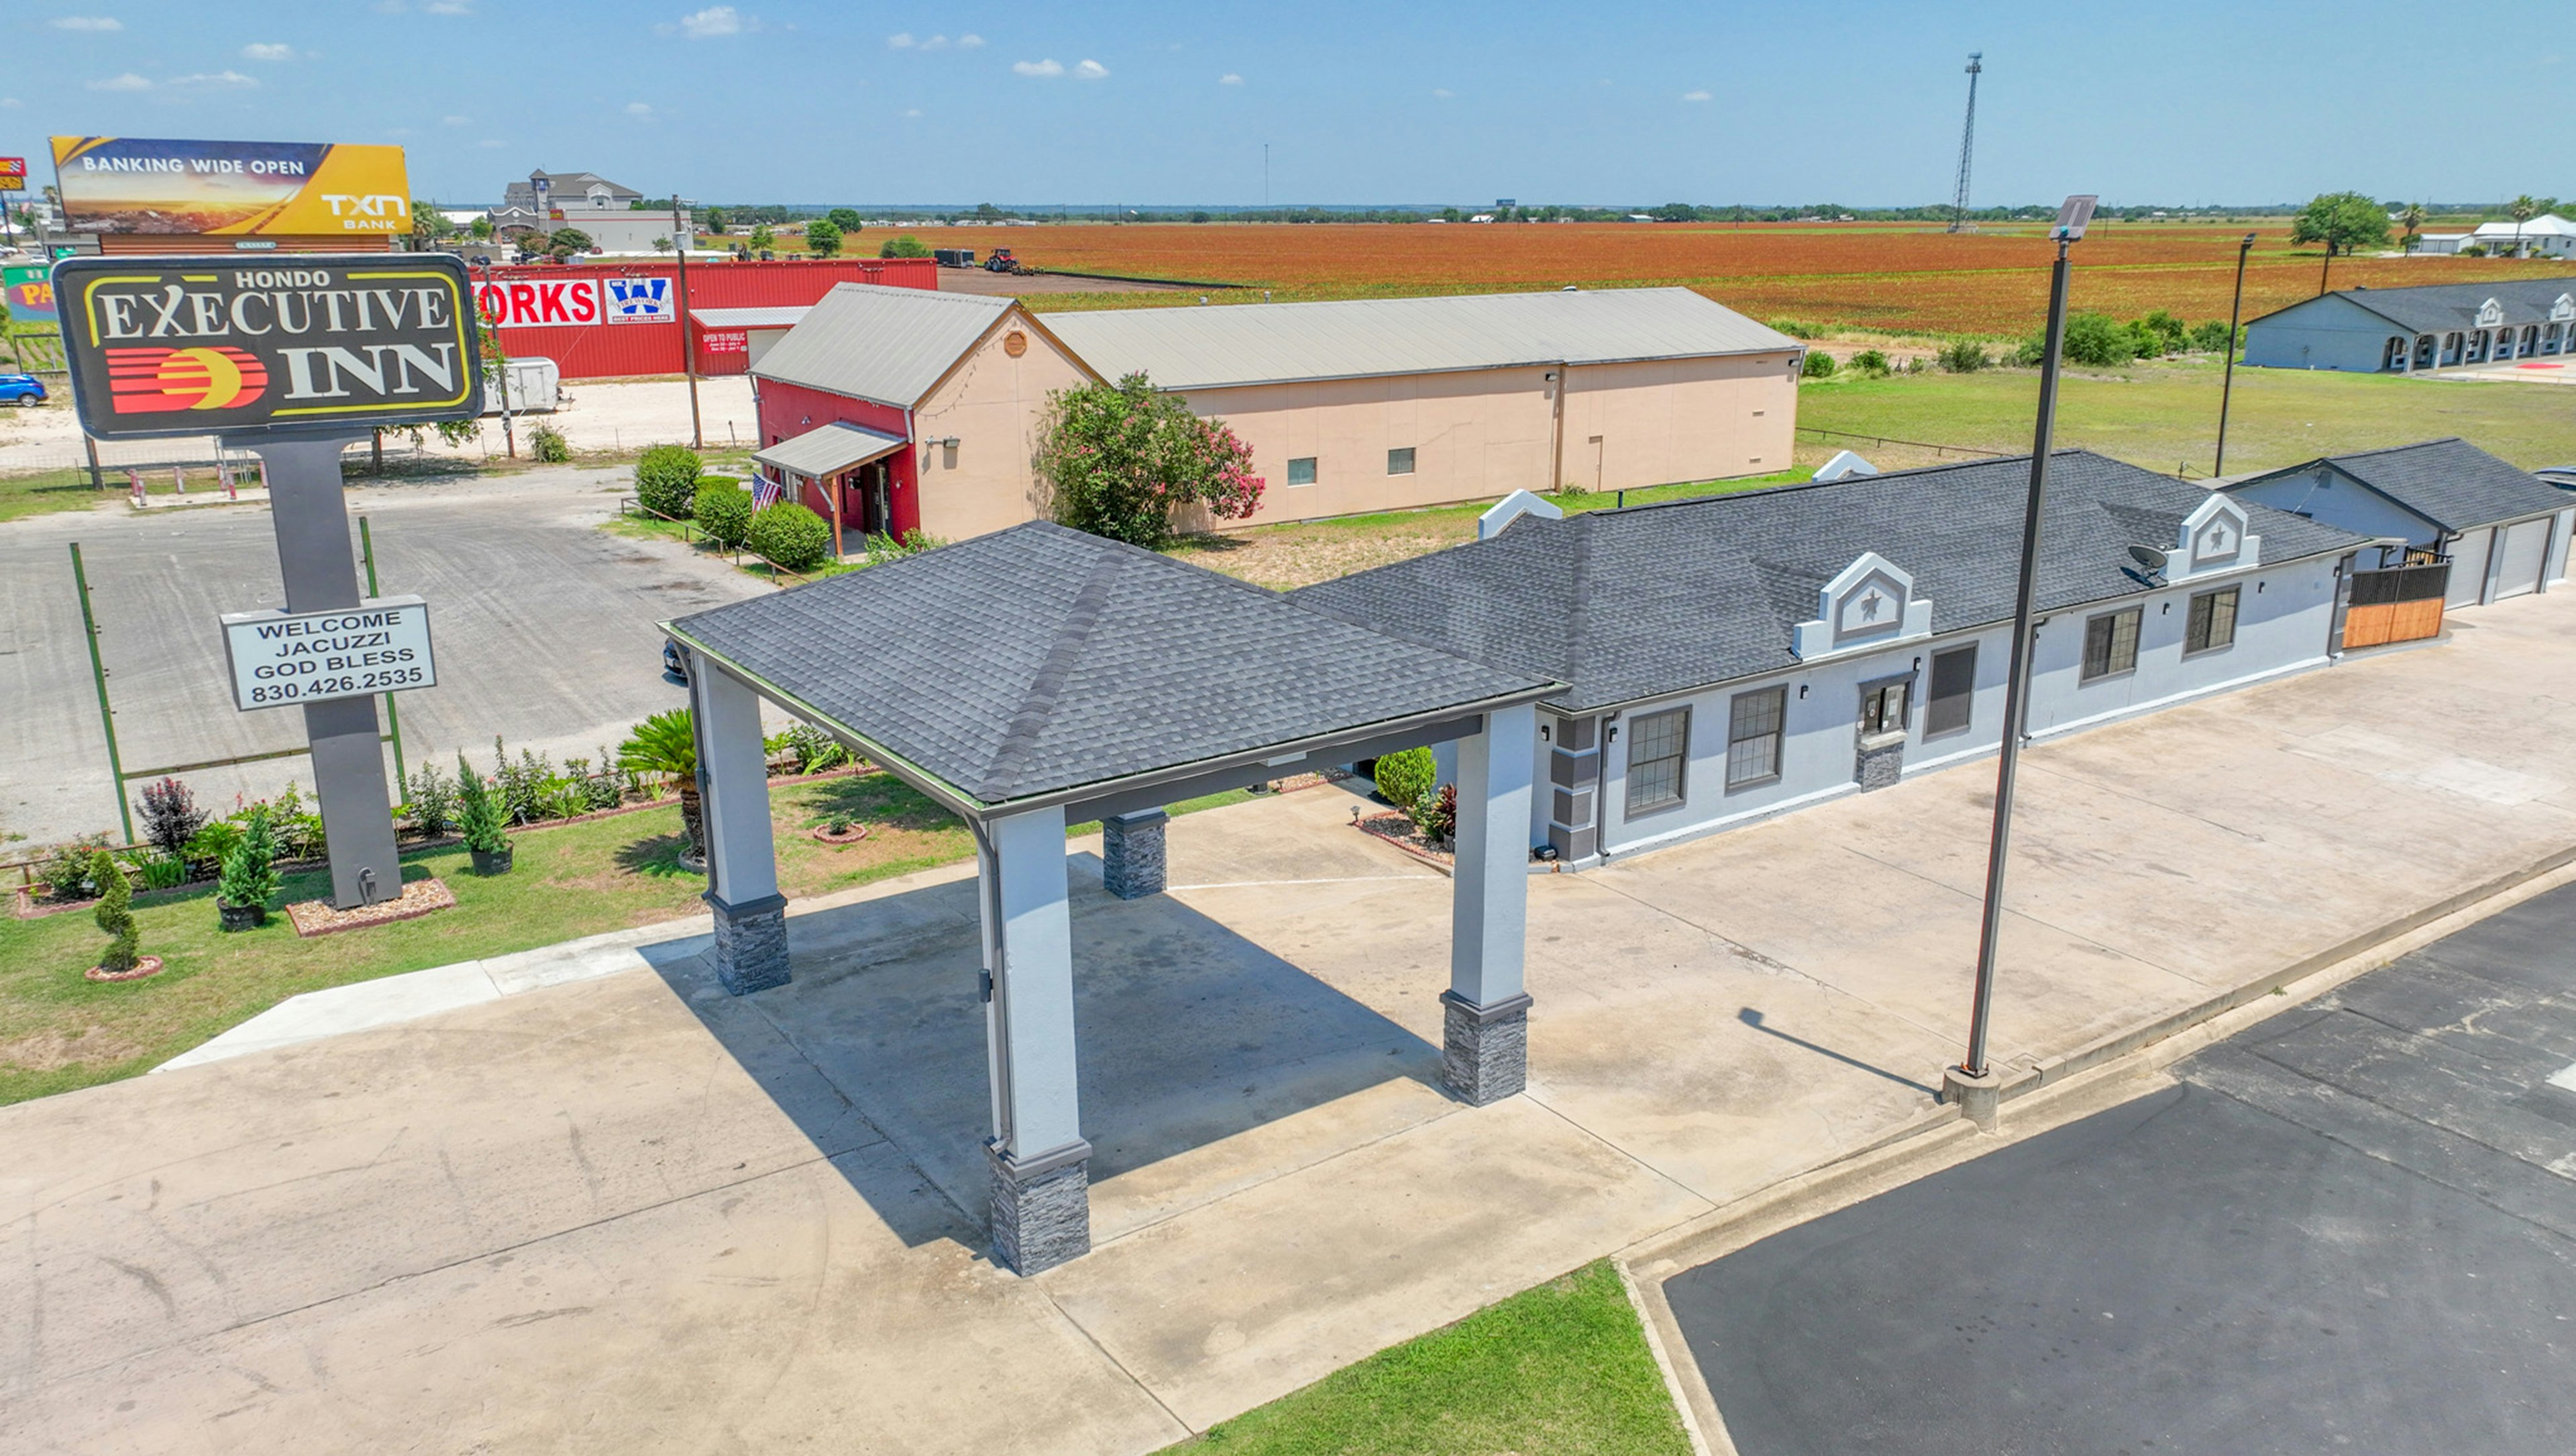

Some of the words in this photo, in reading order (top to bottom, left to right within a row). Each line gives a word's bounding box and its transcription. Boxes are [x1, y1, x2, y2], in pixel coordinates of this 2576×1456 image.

[83, 156, 184, 172] BANKING
[191, 159, 244, 173] WIDE
[250, 160, 305, 174] OPEN
[343, 219, 397, 229] BANK
[235, 270, 330, 288] HONDO
[97, 284, 450, 339] EXECUTIVE
[471, 282, 596, 325] ORKS
[615, 297, 663, 311] FIREWORKS
[702, 334, 718, 343] OPEN
[718, 333, 725, 342] TO
[727, 333, 745, 342] PUBLIC
[277, 342, 455, 399] INN
[257, 611, 402, 639] WELCOME
[276, 631, 391, 658] JACUZZI
[254, 660, 317, 680] GOD
[327, 647, 415, 672] BLESS
[252, 666, 423, 703] 830.426.2535
